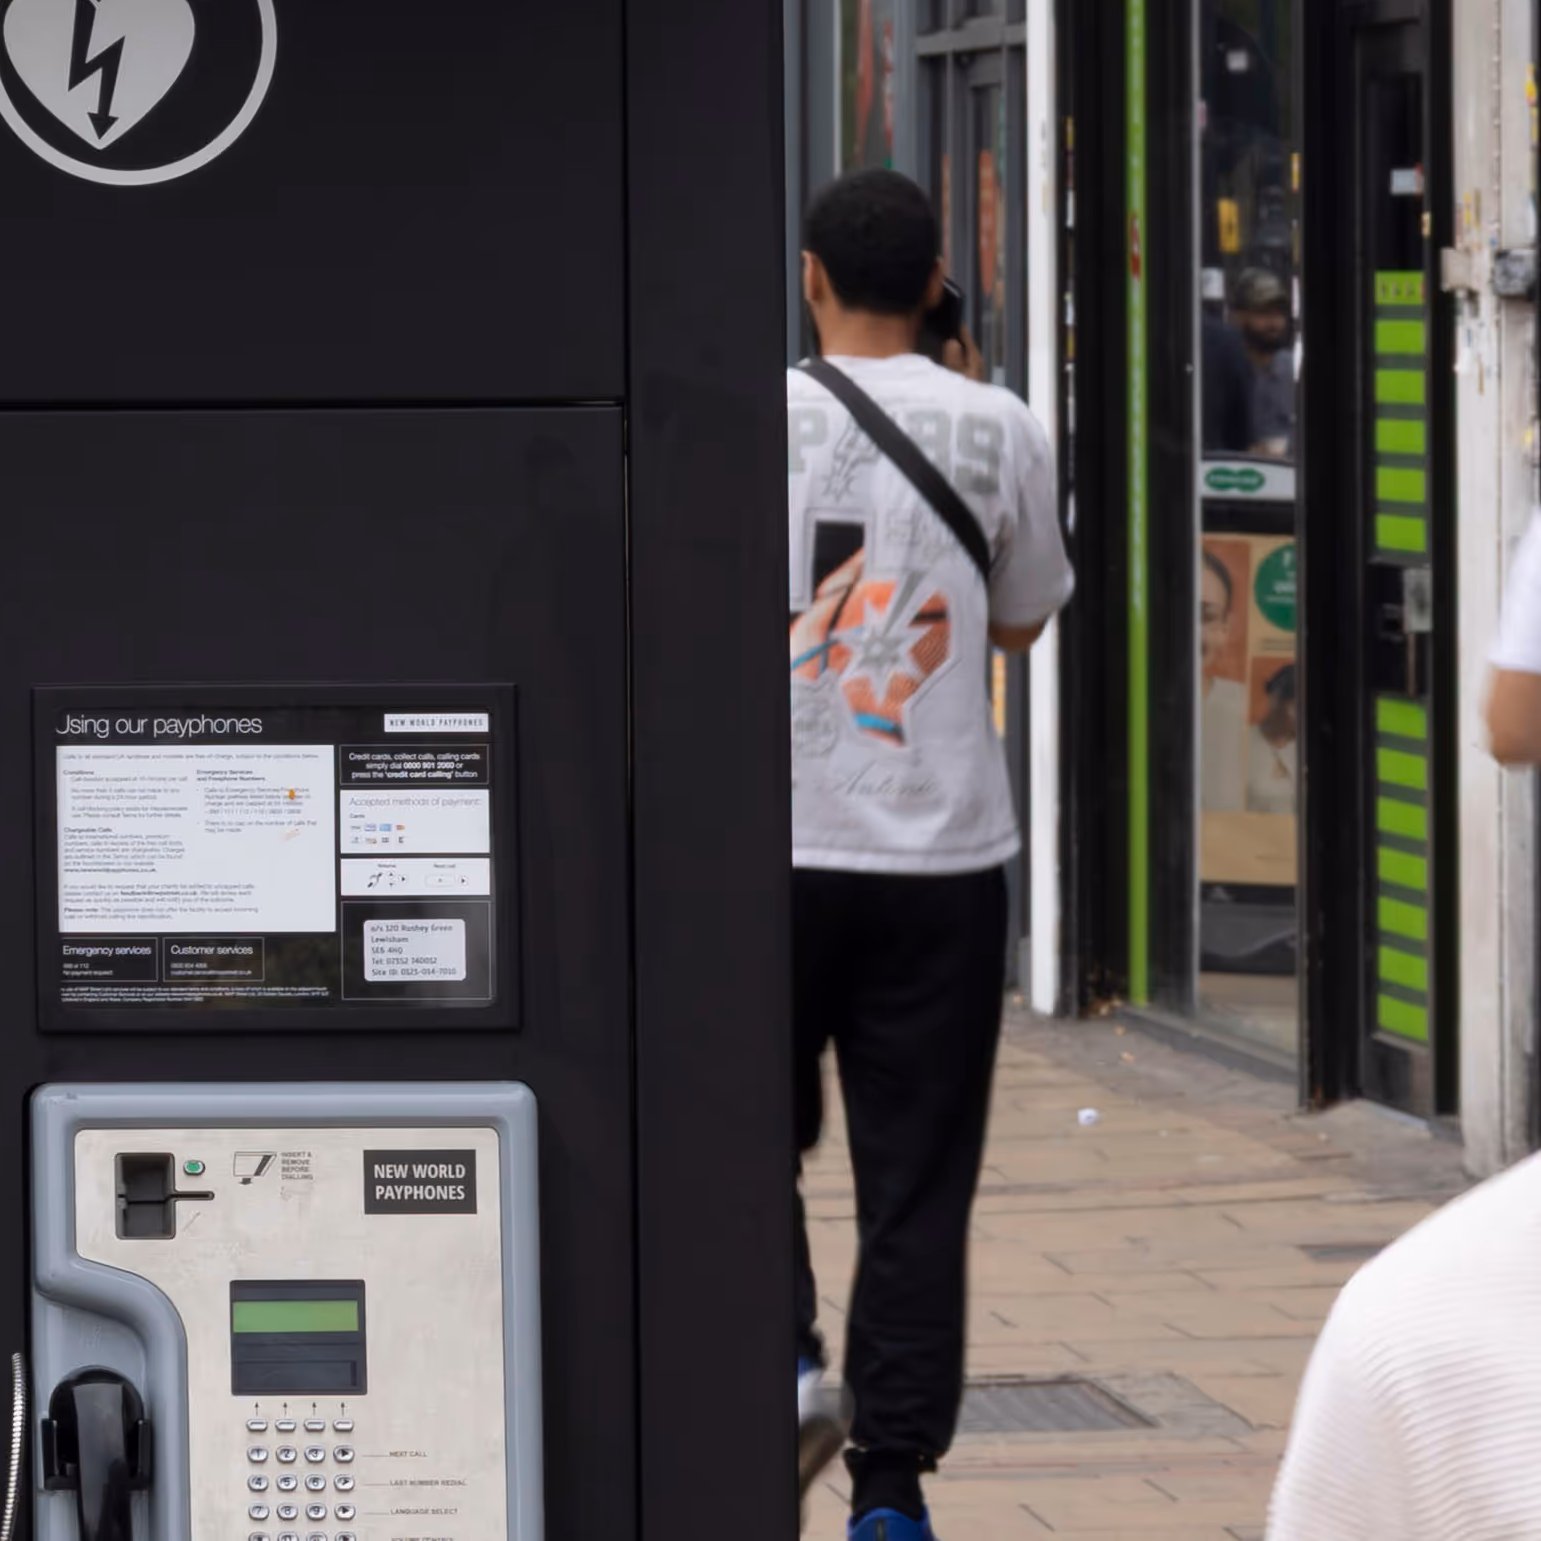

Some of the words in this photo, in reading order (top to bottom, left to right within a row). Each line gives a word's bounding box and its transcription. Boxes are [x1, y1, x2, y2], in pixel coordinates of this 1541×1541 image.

[115, 716, 148, 734] our
[153, 714, 263, 738] payphones
[349, 752, 370, 760] Credit
[349, 796, 390, 807] Accepted
[392, 795, 431, 805] methods
[432, 795, 441, 805] of
[62, 945, 114, 957] Emergency
[115, 945, 153, 955] services
[170, 945, 215, 955] Customer
[216, 945, 254, 955] services
[374, 1163, 410, 1180] NEW
[412, 1163, 466, 1180] WORLD
[375, 1184, 466, 1201] PAYPHONES
